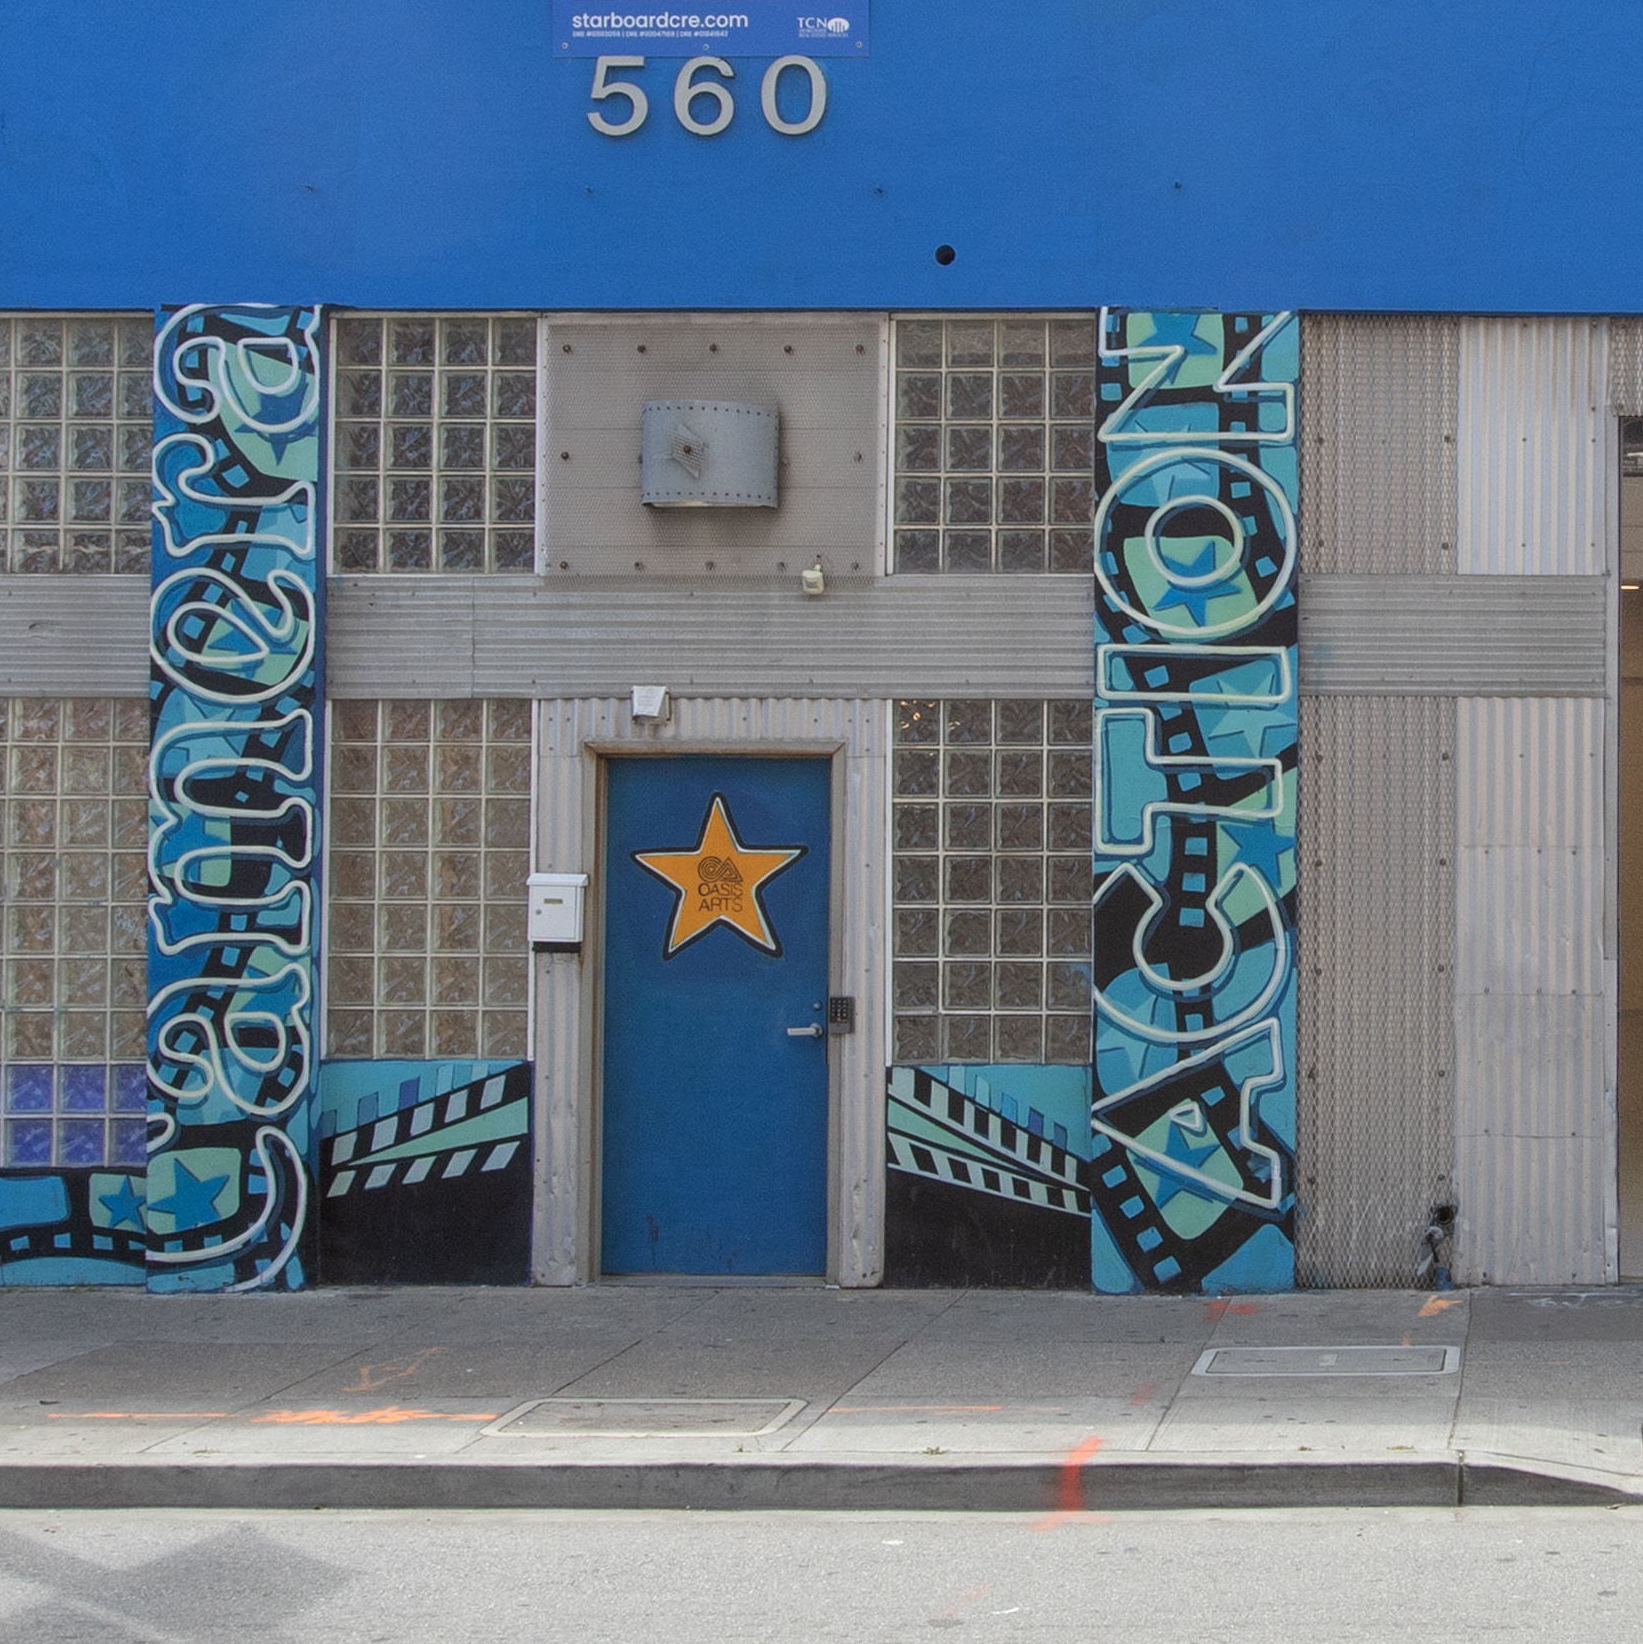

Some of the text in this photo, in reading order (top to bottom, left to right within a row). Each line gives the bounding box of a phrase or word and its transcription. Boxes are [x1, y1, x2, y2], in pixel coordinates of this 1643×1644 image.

[572, 12, 748, 28] starboardcre.com
[797, 17, 827, 29] TCN
[586, 56, 828, 136] 560
[1092, 308, 1298, 1212] ACTION
[147, 303, 323, 1293] Camera
[698, 882, 743, 896] OASIS
[698, 897, 743, 912] ARTS
